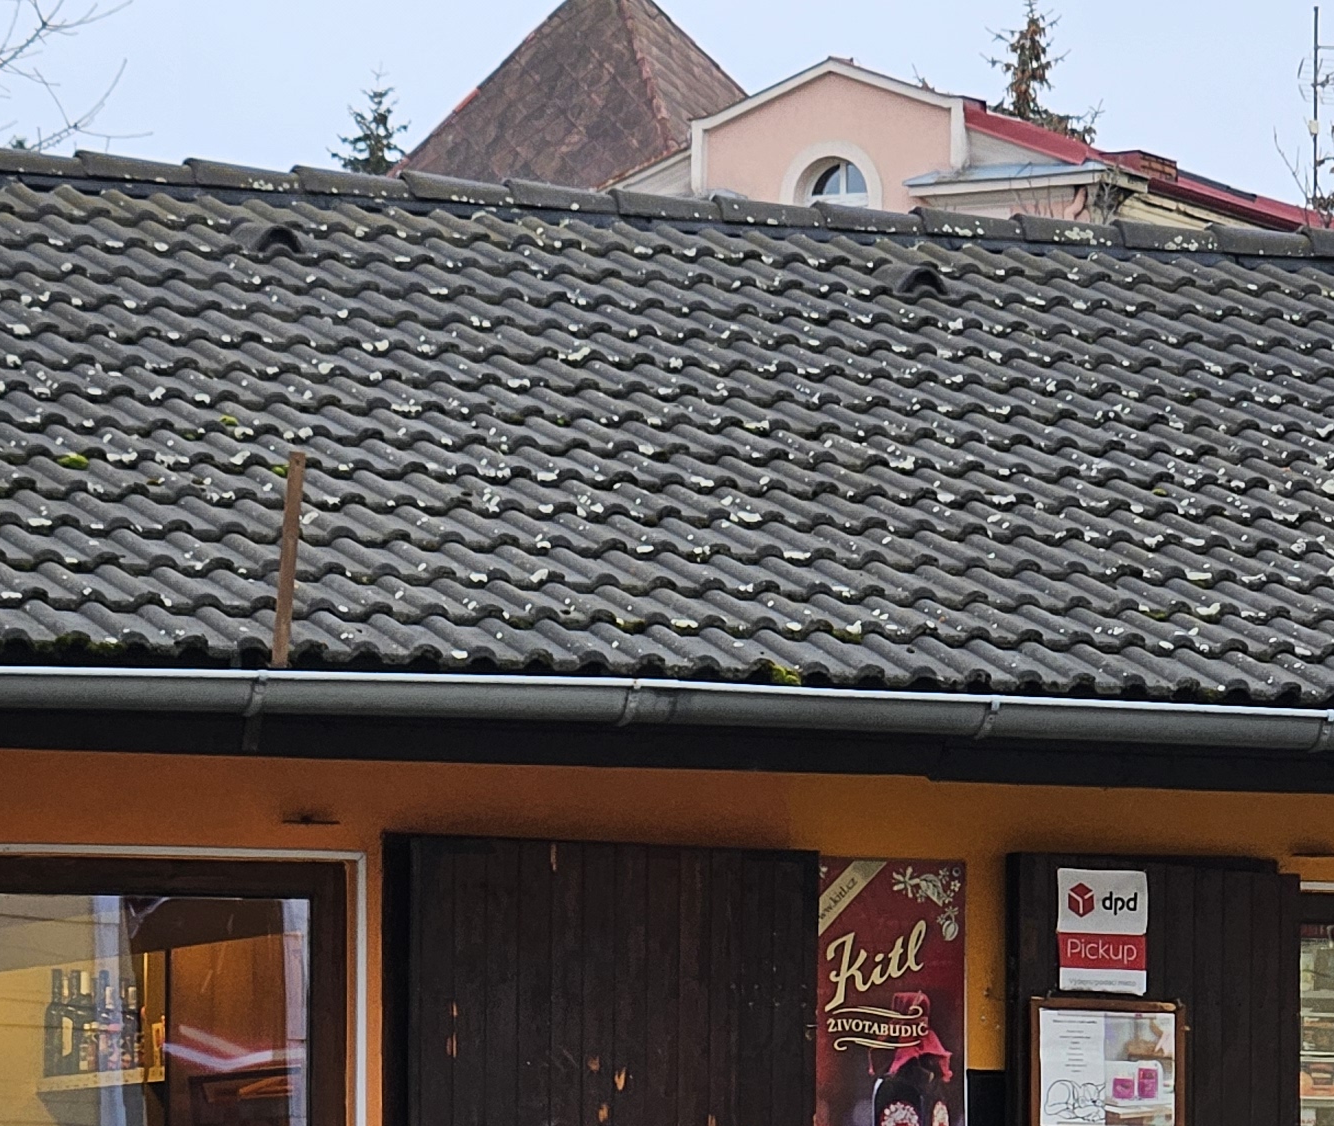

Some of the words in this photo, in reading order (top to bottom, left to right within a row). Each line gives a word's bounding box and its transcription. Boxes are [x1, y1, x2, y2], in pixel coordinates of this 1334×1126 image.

[1102, 891, 1138, 915] dpd
[1067, 938, 1137, 964] Pickup
[824, 920, 927, 1013] Kitl
